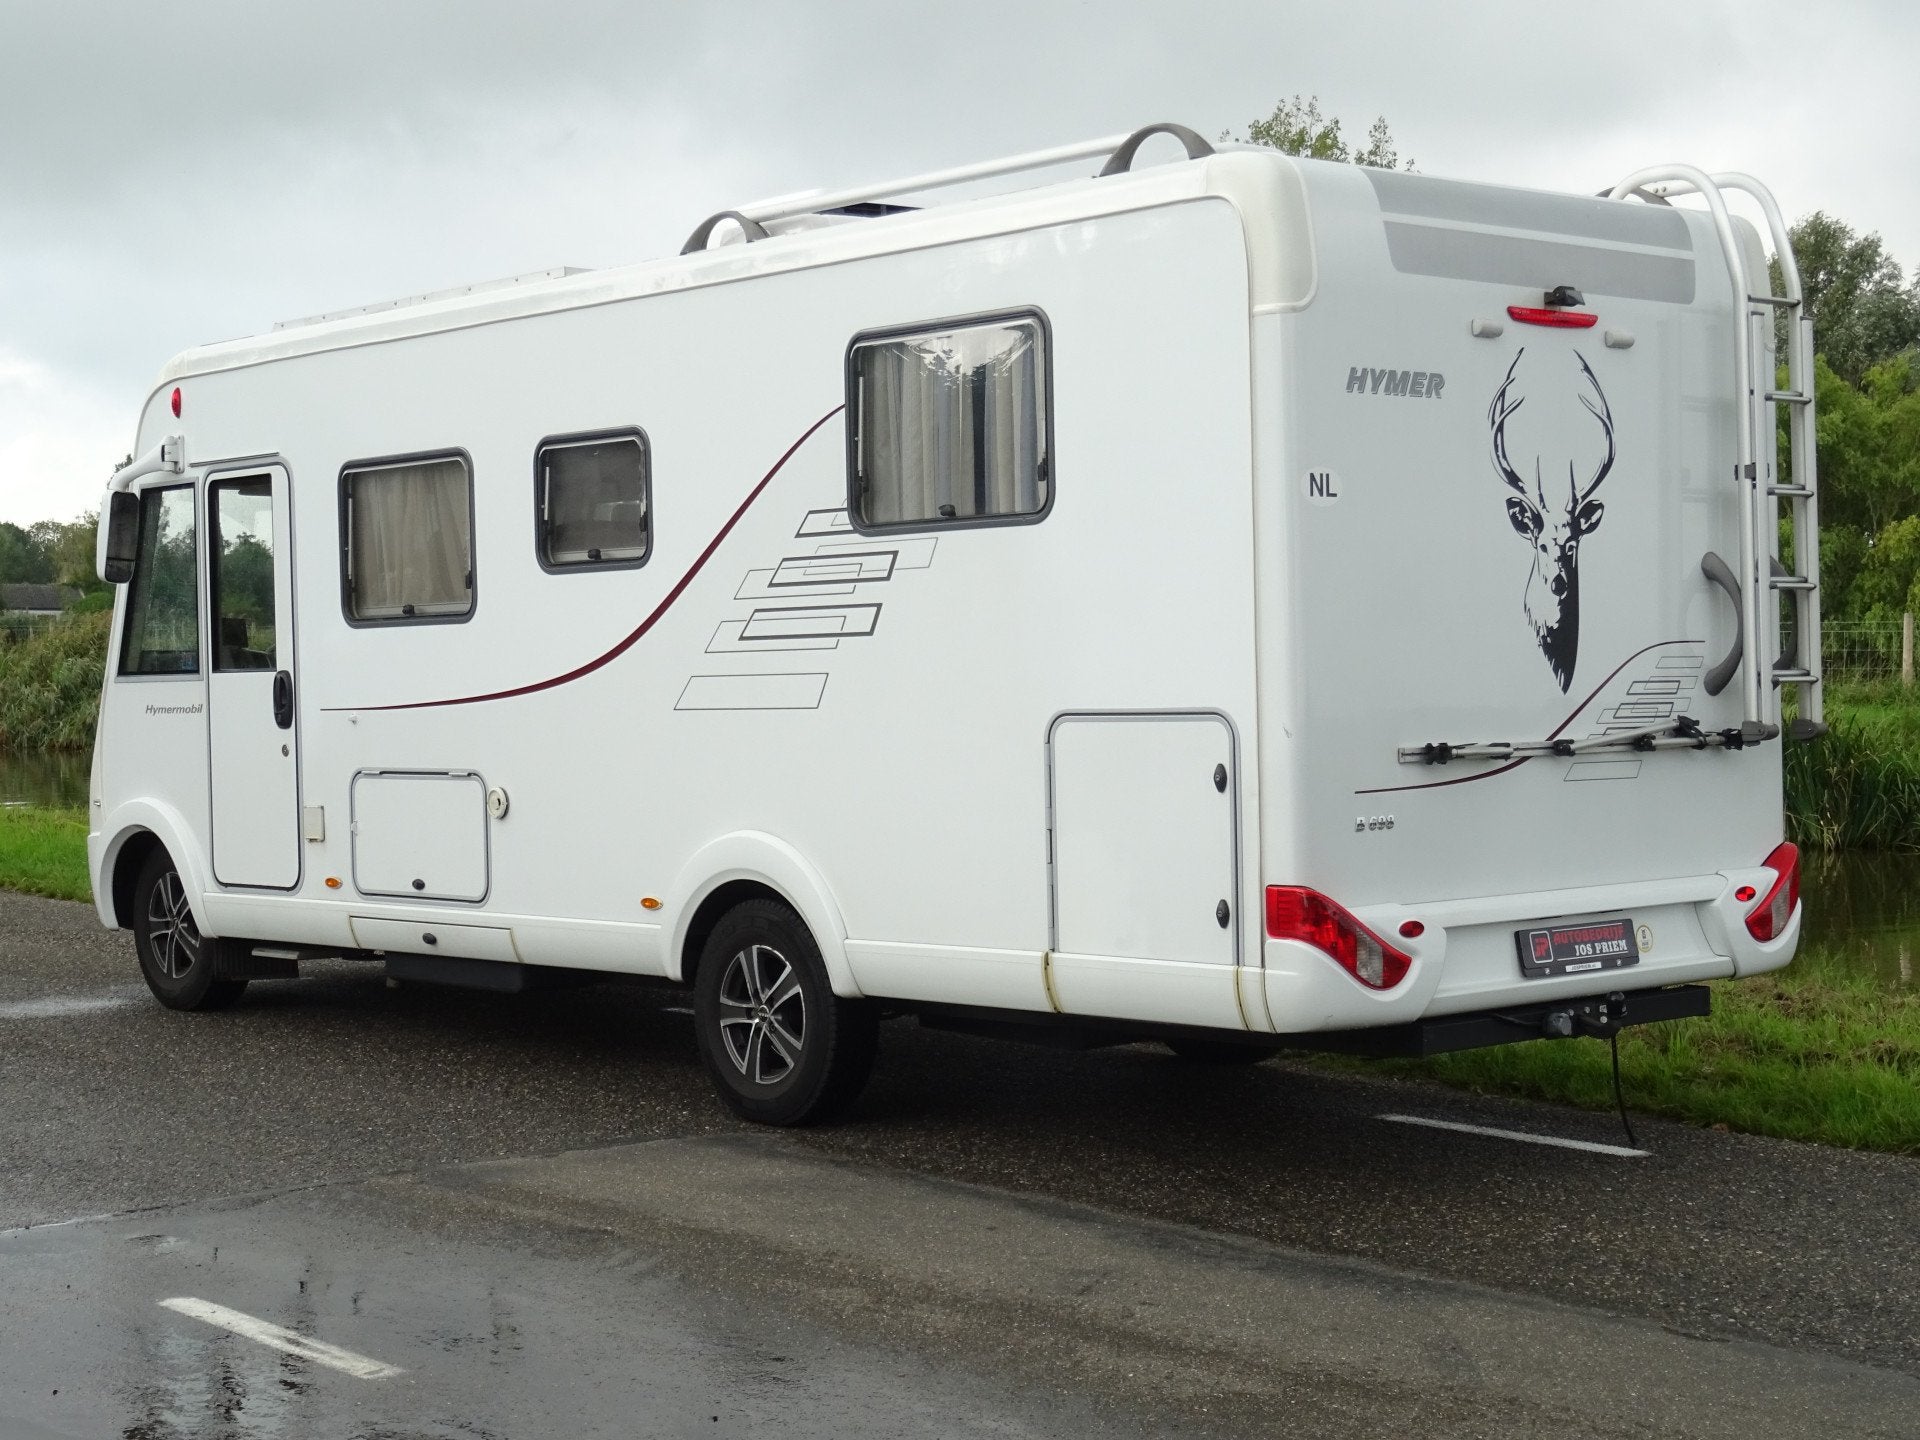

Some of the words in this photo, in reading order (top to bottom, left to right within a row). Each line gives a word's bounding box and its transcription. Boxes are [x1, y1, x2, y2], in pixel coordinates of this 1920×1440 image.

[1345, 367, 1446, 399] HYMER
[1310, 472, 1338, 498] NL
[145, 703, 203, 716] Hymermobil
[1574, 943, 1593, 957] JOS
[1594, 939, 1628, 954] PRIEM
